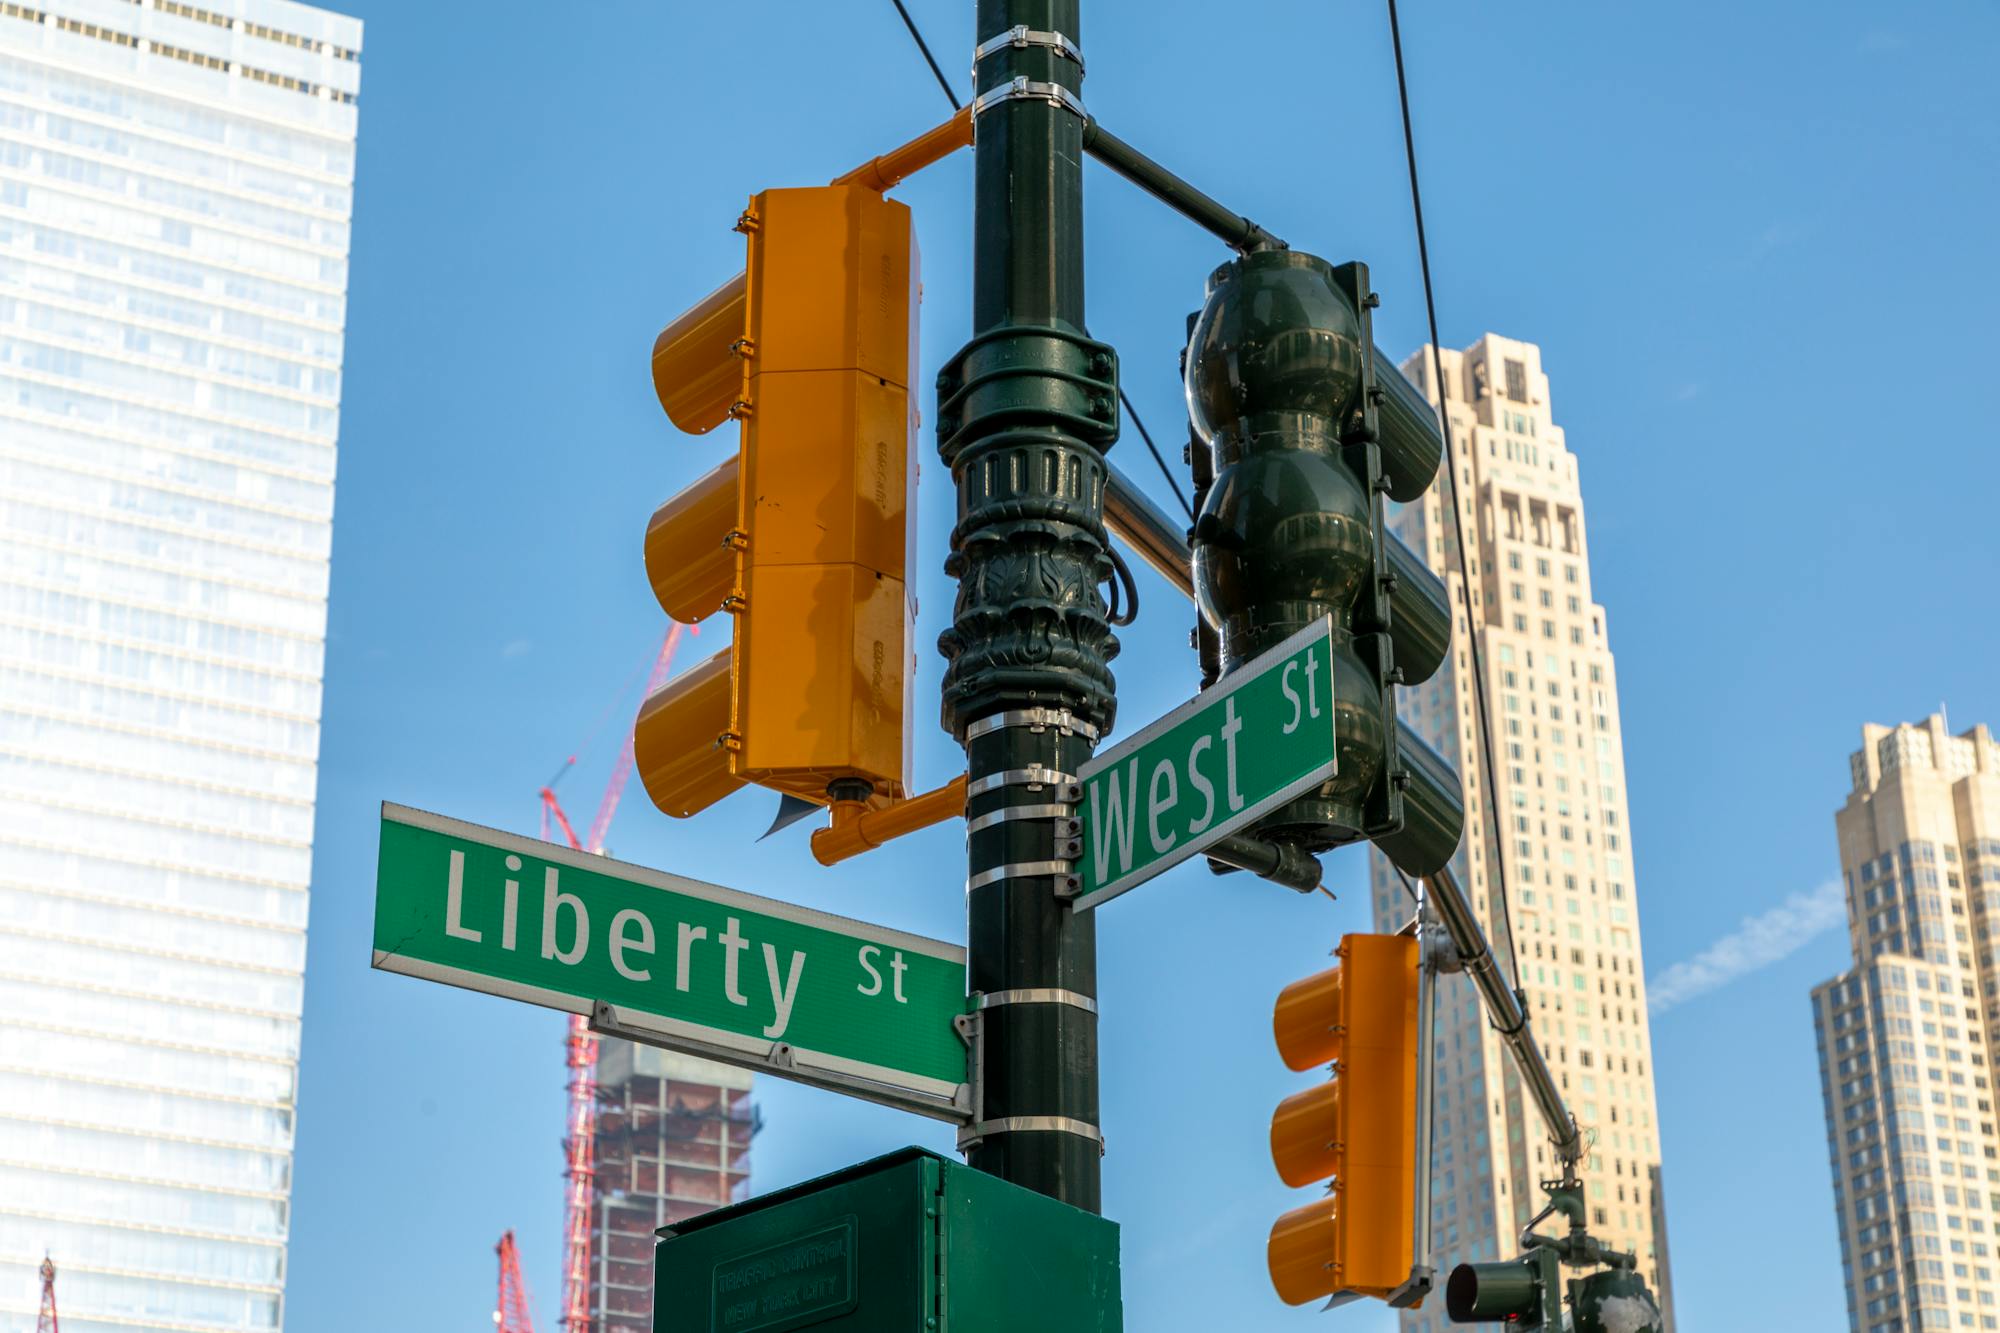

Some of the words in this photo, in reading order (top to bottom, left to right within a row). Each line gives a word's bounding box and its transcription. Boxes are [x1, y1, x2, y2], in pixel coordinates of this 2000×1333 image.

[1090, 695, 1244, 886] West
[1282, 648, 1321, 735] St
[445, 849, 806, 1039] Liberty
[857, 945, 908, 1004] St
[719, 1261, 776, 1293] TRAFFIC
[783, 1239, 847, 1273] CONTROL
[725, 1300, 757, 1325] NEW
[762, 1287, 800, 1313] YORK
[802, 1274, 837, 1300] CITY
